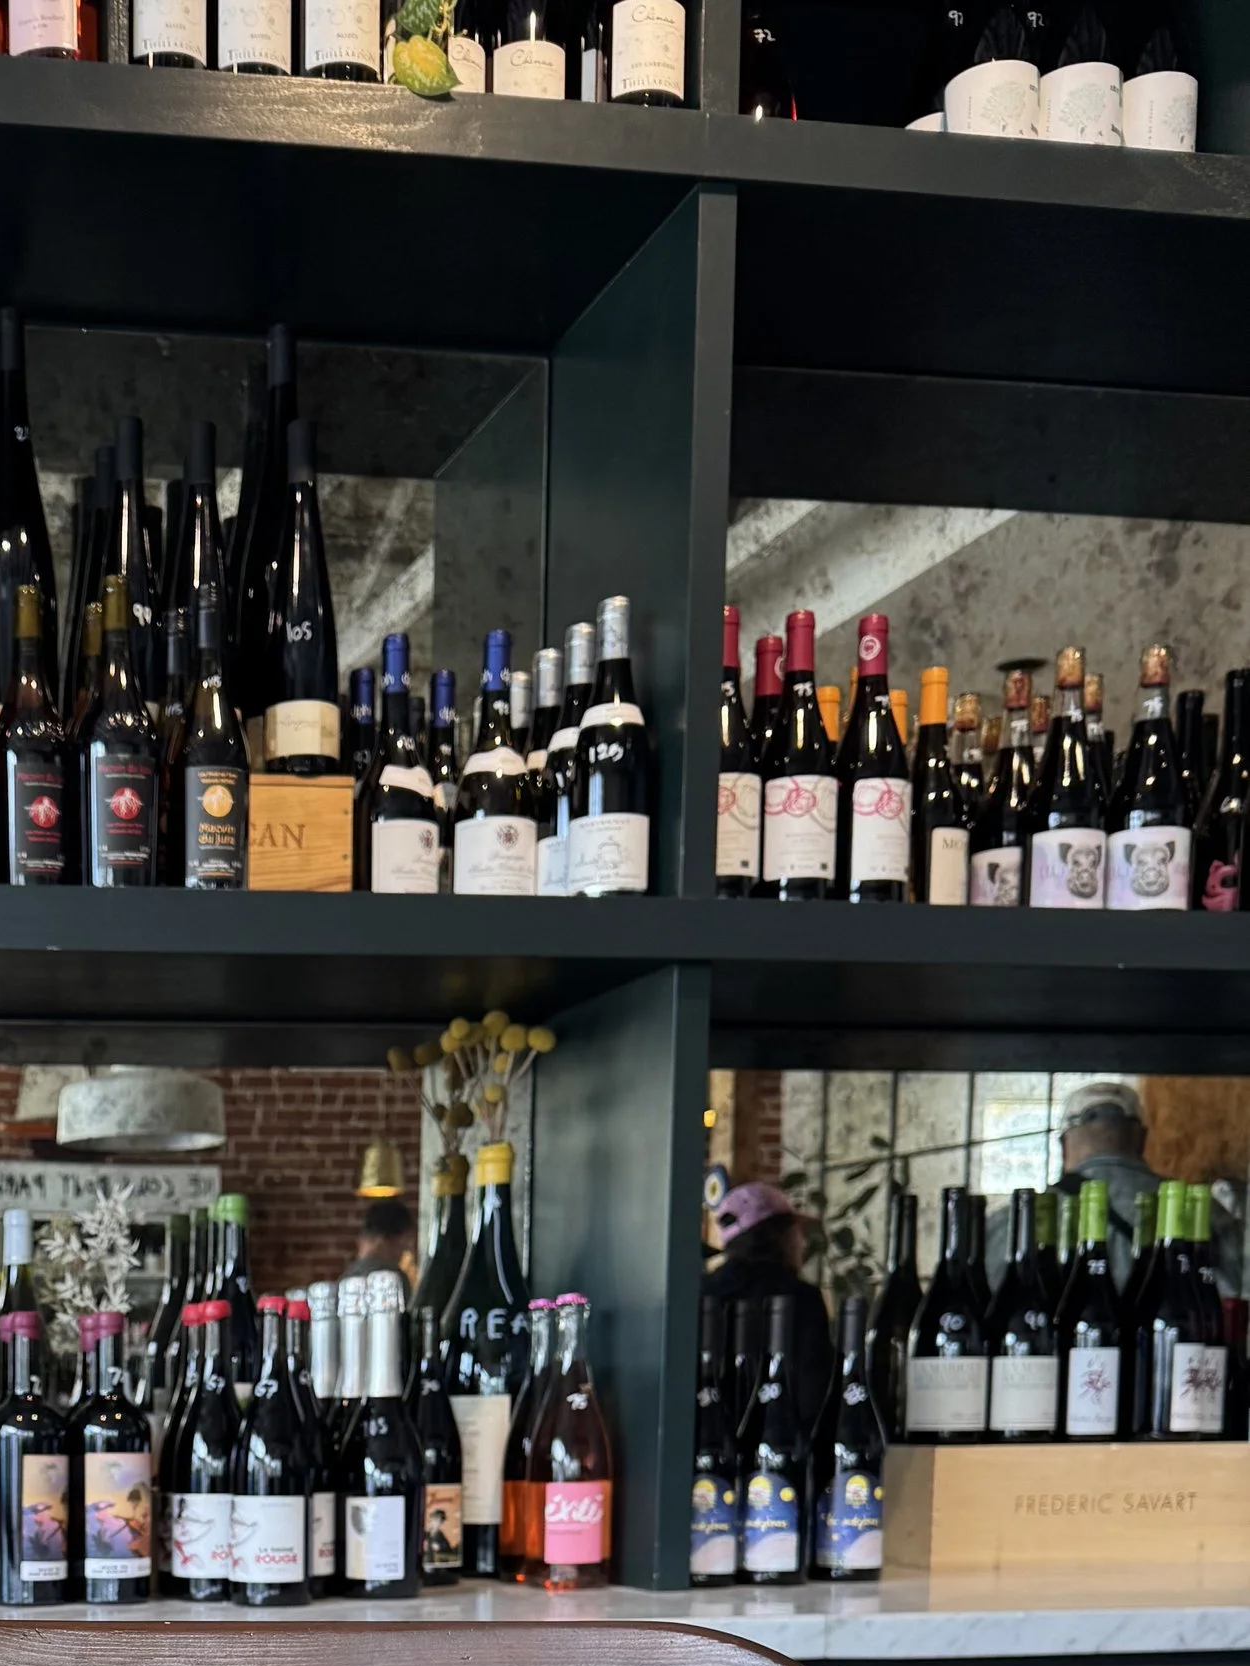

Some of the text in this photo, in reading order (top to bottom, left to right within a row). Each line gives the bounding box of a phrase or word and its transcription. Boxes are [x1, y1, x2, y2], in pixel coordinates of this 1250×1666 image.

[752, 28, 776, 43] 72
[1013, 1491, 1199, 1516] FREDERIC SAVART
[254, 1553, 299, 1565] ROUGE
